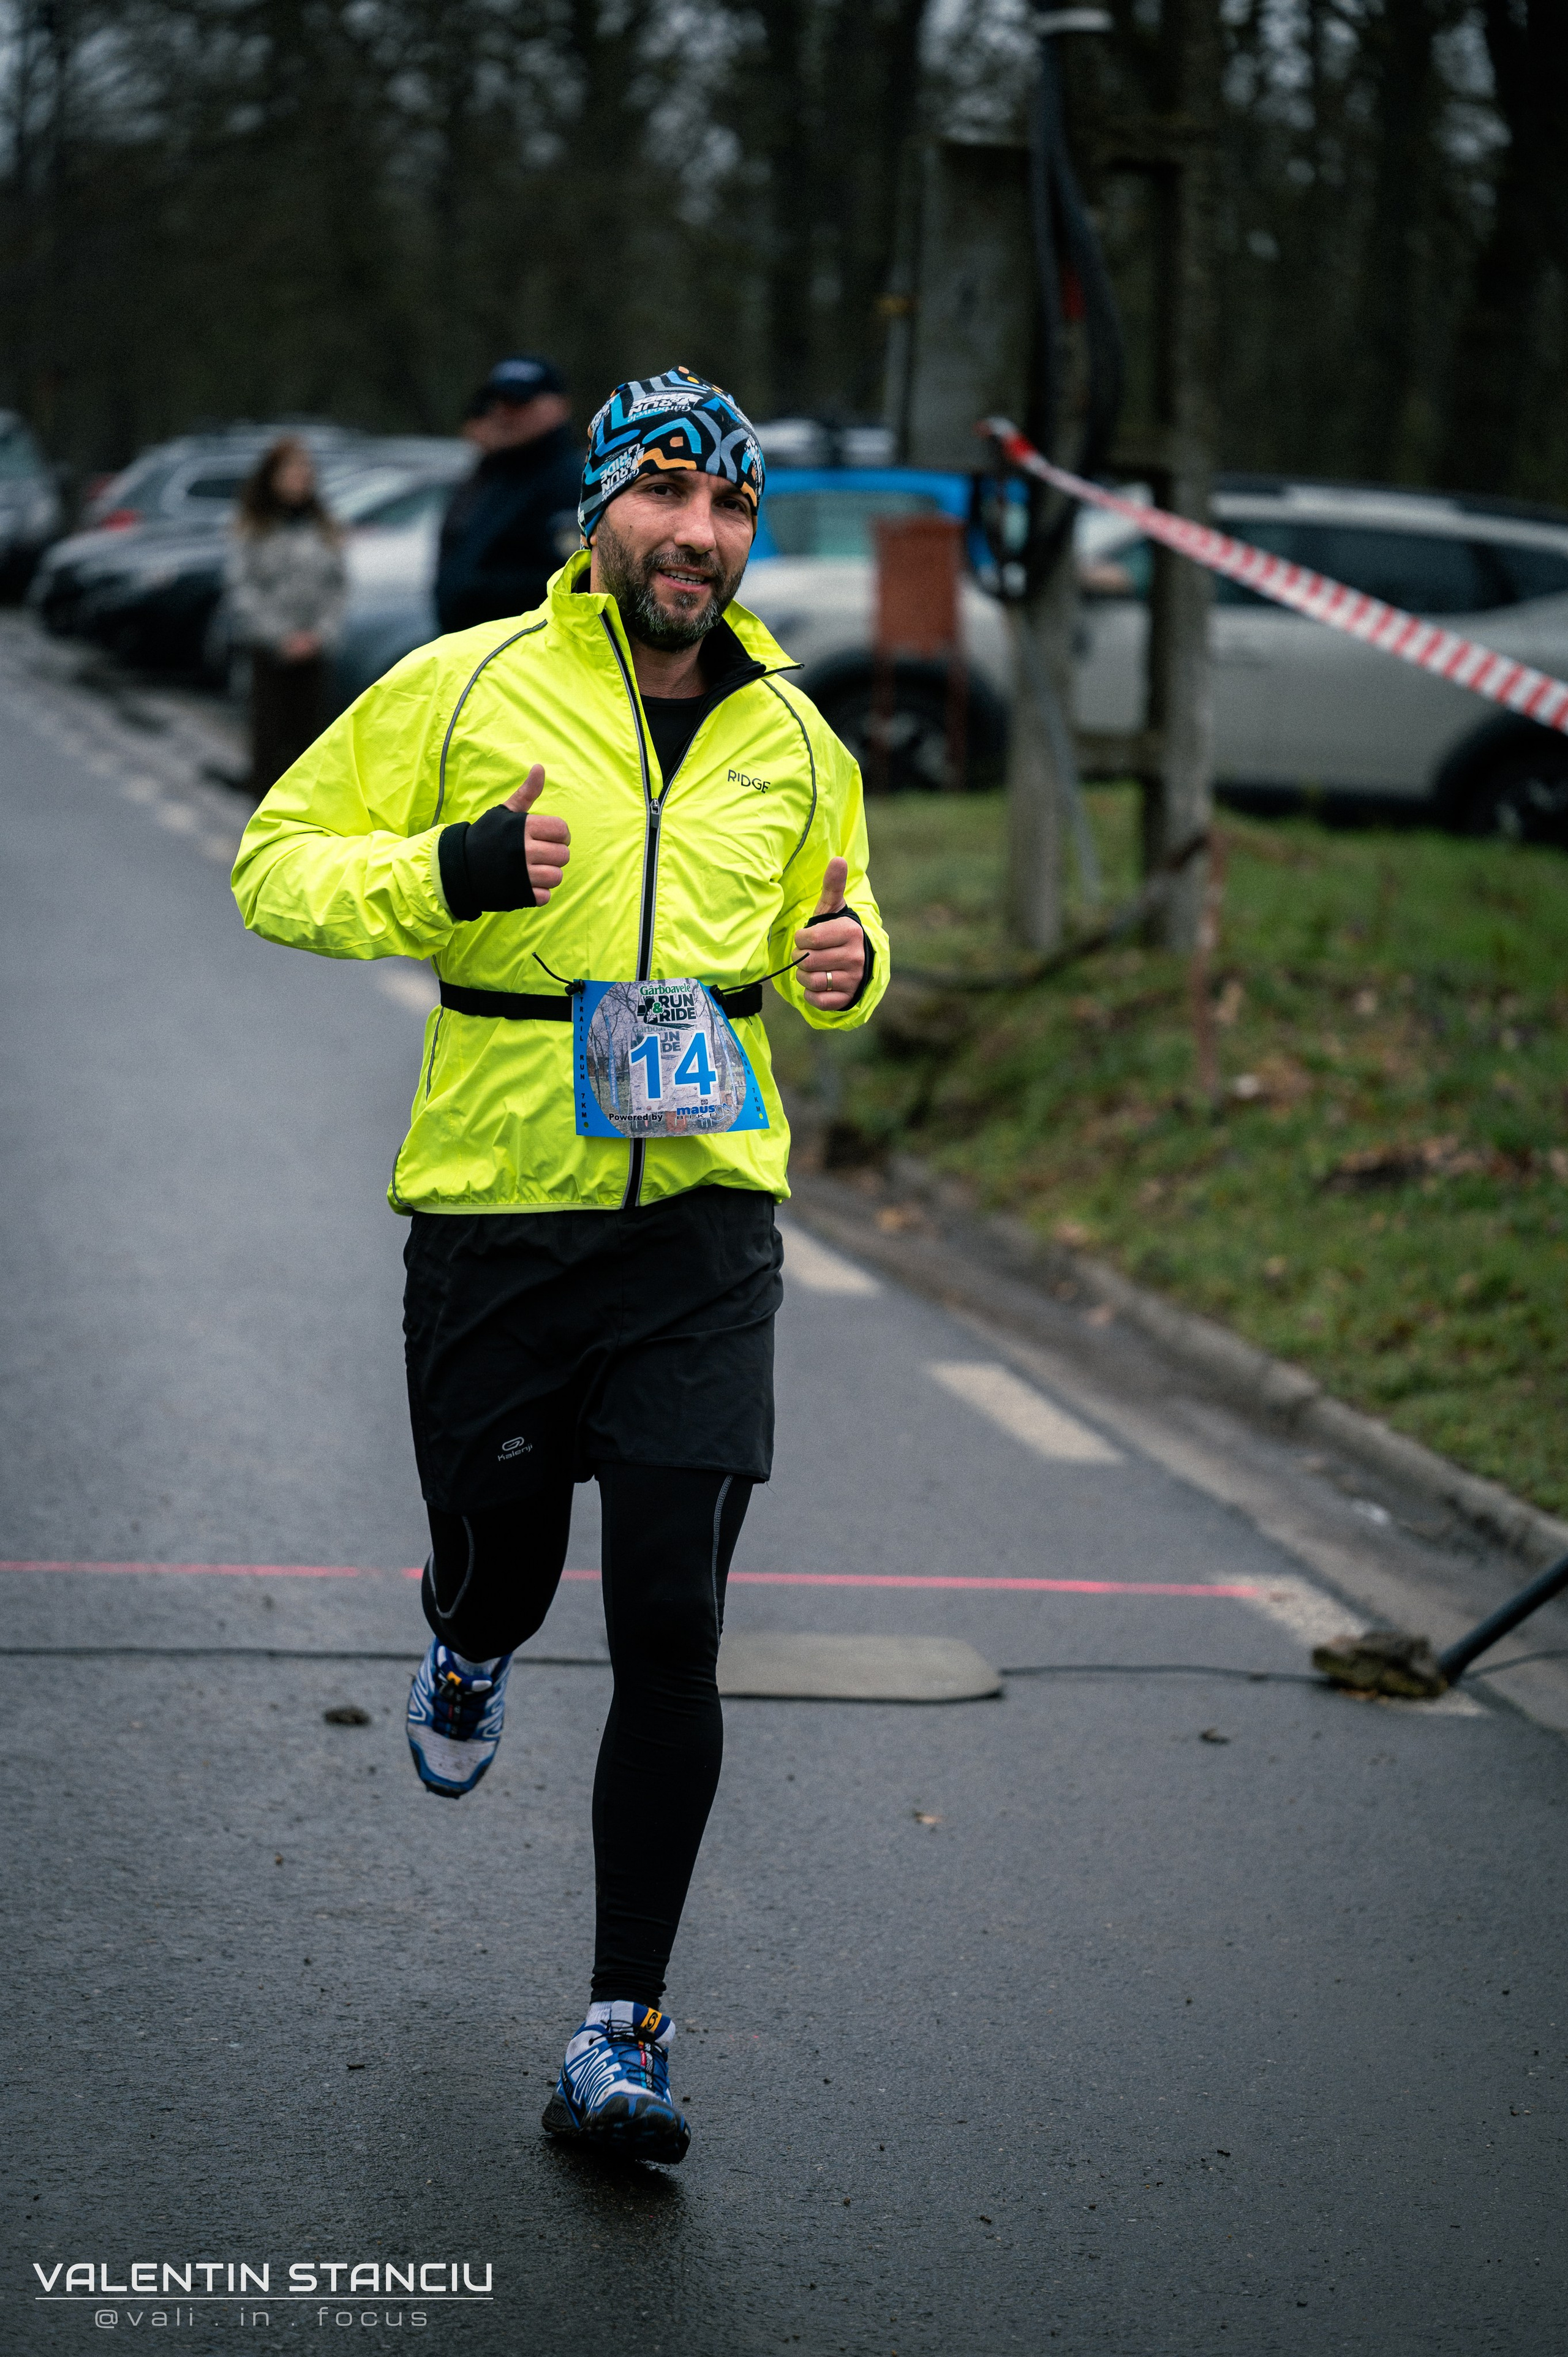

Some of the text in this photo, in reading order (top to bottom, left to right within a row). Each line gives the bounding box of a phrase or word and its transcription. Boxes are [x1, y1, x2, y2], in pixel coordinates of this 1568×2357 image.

[600, 451, 628, 484] RIDE
[601, 467, 628, 496] RUN
[727, 769, 771, 794] RIDGE
[639, 983, 692, 995] Gârboavele
[658, 994, 695, 1008] RUN
[652, 1002, 696, 1022] & RIDE
[630, 1032, 717, 1099] 14
[652, 1114, 663, 1122] by
[676, 1105, 715, 1115] maus
